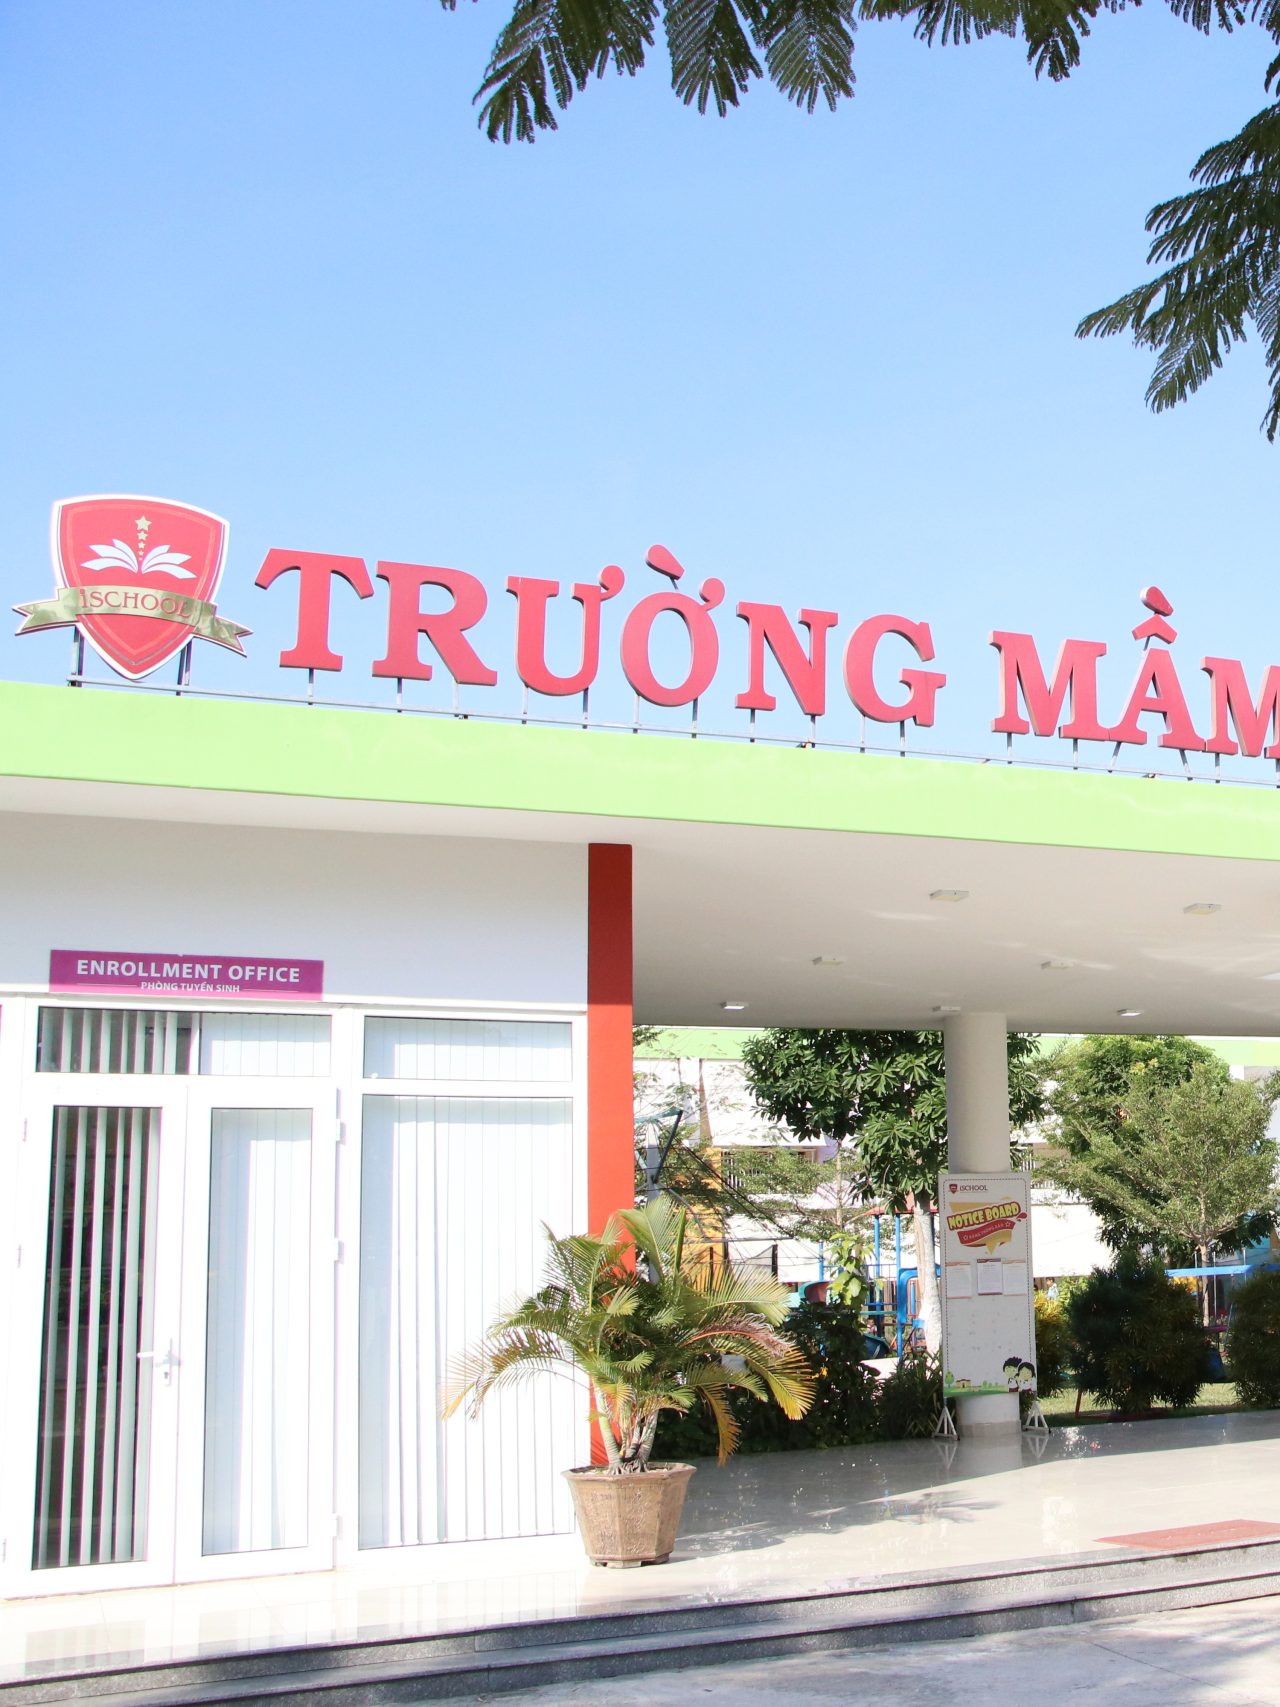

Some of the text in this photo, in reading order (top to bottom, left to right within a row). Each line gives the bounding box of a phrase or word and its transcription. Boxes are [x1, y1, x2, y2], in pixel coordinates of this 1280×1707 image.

[80, 589, 192, 618] iSCHOOL
[255, 544, 946, 727] TRƯỜNG
[76, 959, 300, 983] ENROLLMENT OFFICE
[141, 981, 178, 992] PHÒNG
[216, 984, 240, 993] SINH
[948, 1202, 1021, 1230] NOTICE BOARD
